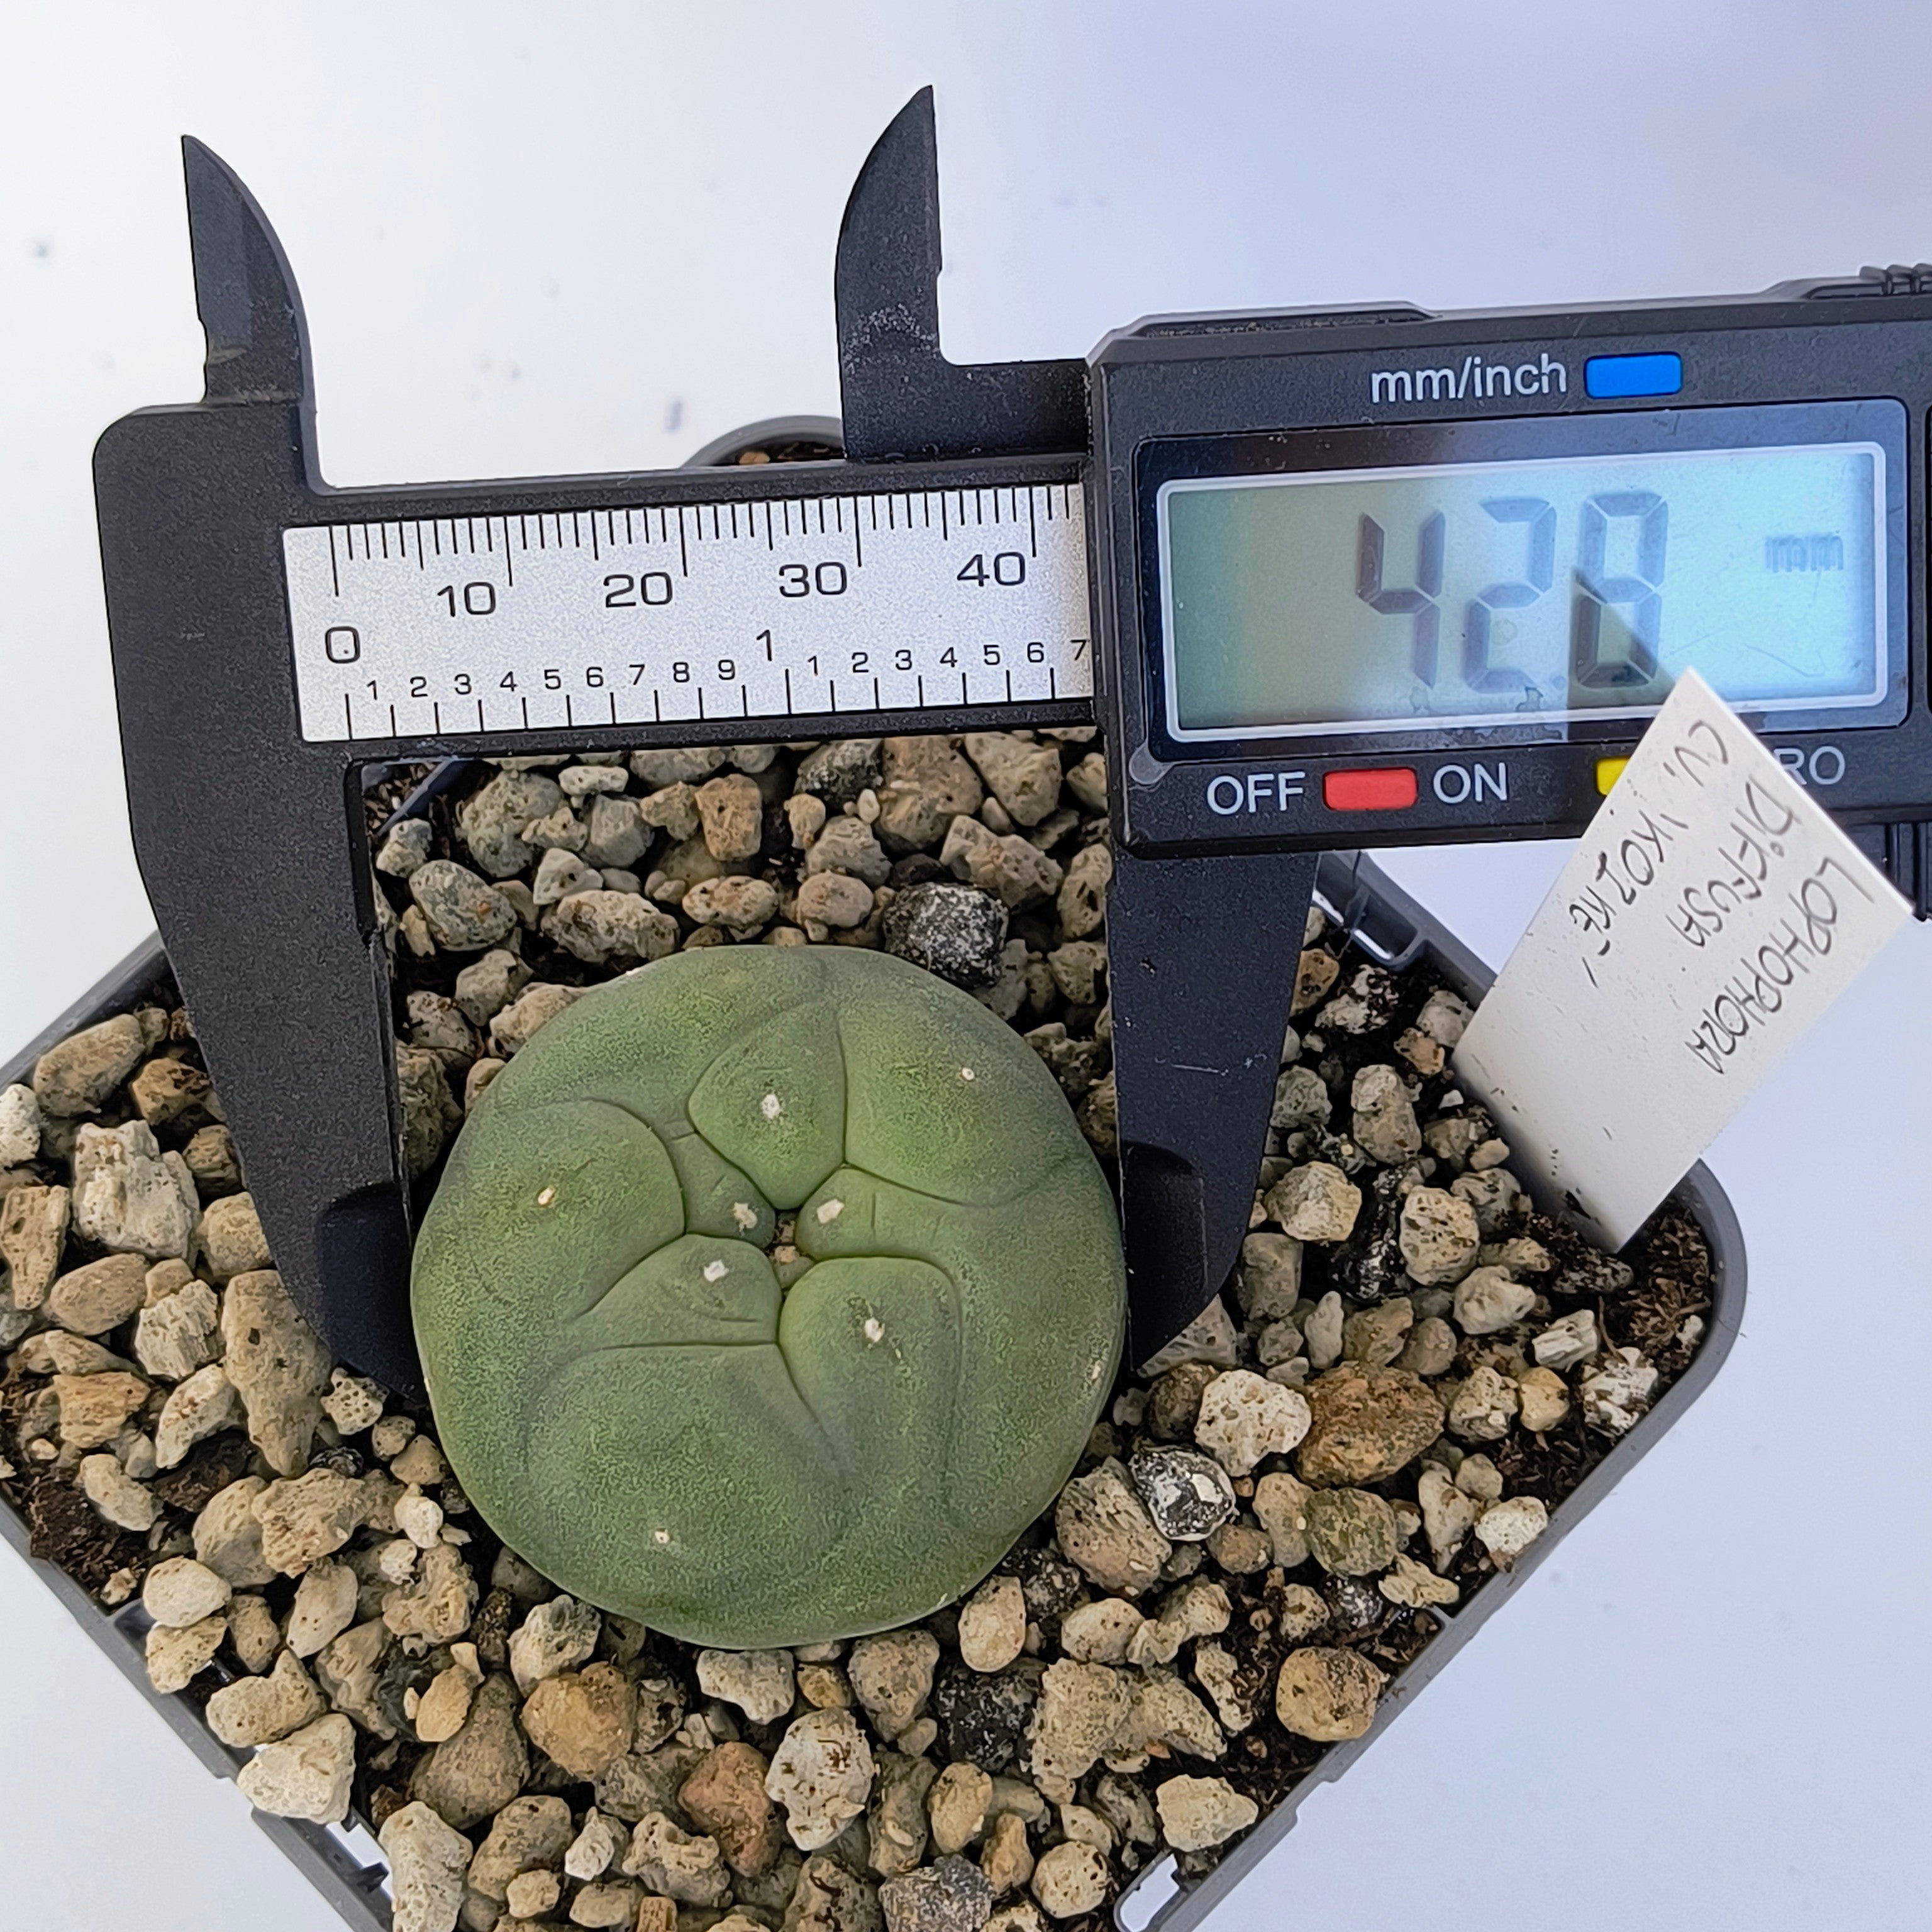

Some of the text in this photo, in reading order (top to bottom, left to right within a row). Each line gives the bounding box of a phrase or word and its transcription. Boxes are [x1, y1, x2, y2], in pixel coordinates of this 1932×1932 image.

[1371, 352, 1567, 404] mm/inch
[1765, 531, 1845, 574] mm
[436, 552, 1026, 618] 10 20 30 40
[325, 626, 360, 664] 0
[755, 629, 773, 662] 1
[807, 639, 1091, 675] 1 2 3 4 5 6 7
[366, 659, 736, 701] 1 2 3 4 5 6 7 8 9
[1208, 745, 1846, 814] OFF ON RO
[1684, 856, 1875, 1075] LOPHOPHORA
